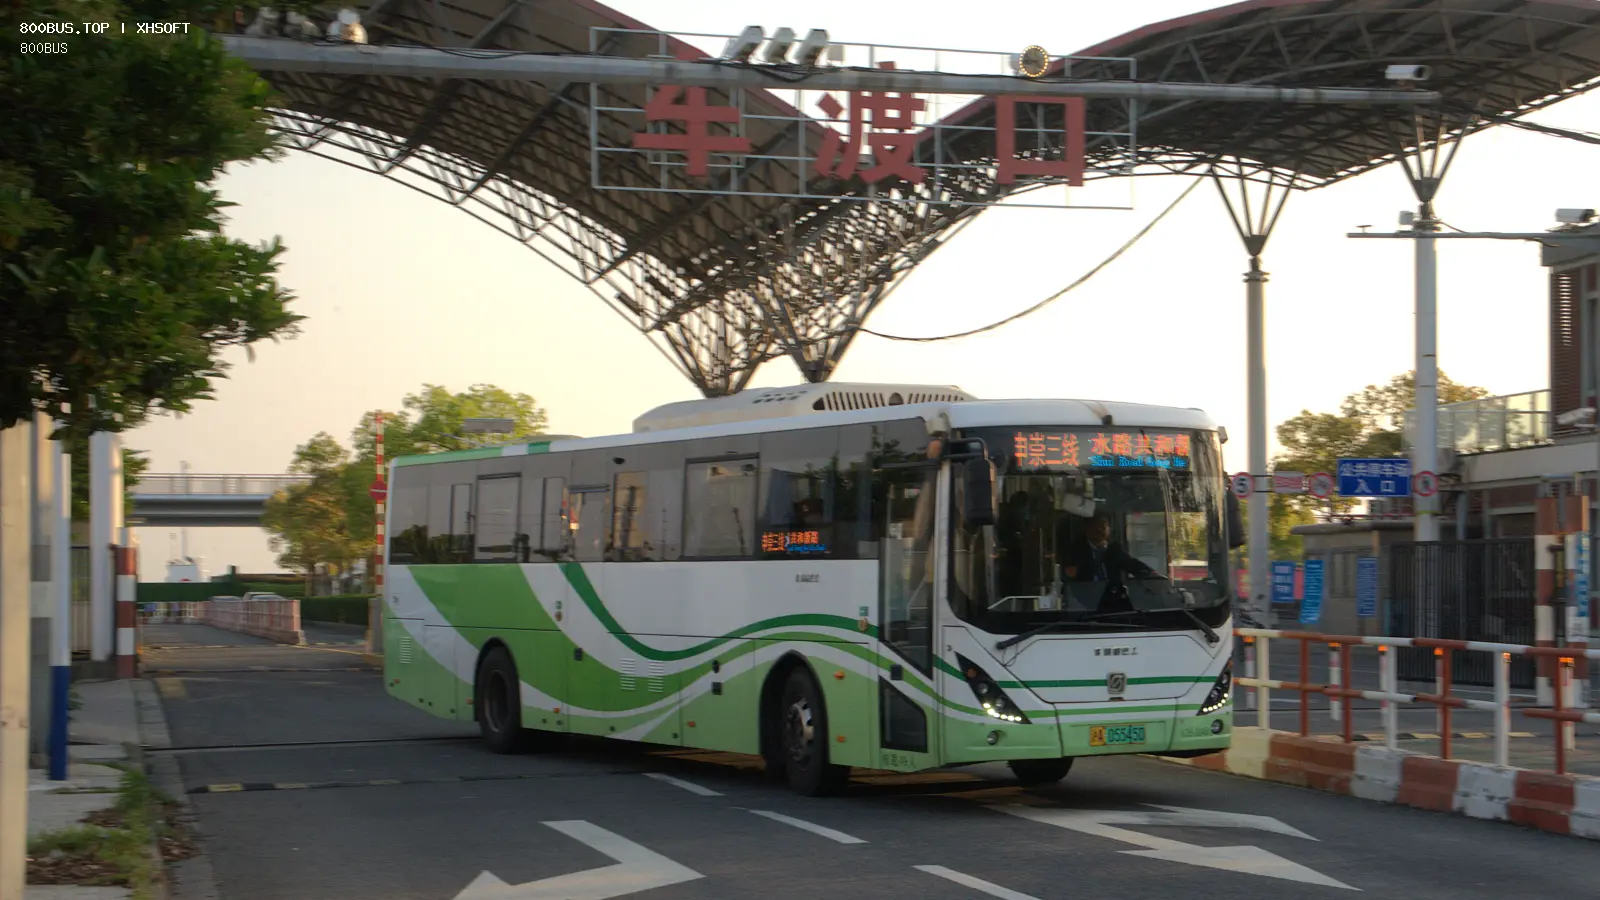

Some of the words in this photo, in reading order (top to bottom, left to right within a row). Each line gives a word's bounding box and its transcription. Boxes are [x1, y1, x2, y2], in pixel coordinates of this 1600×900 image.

[1014, 431, 1080, 467] 申崇三线
[1353, 479, 1396, 494] 入口
